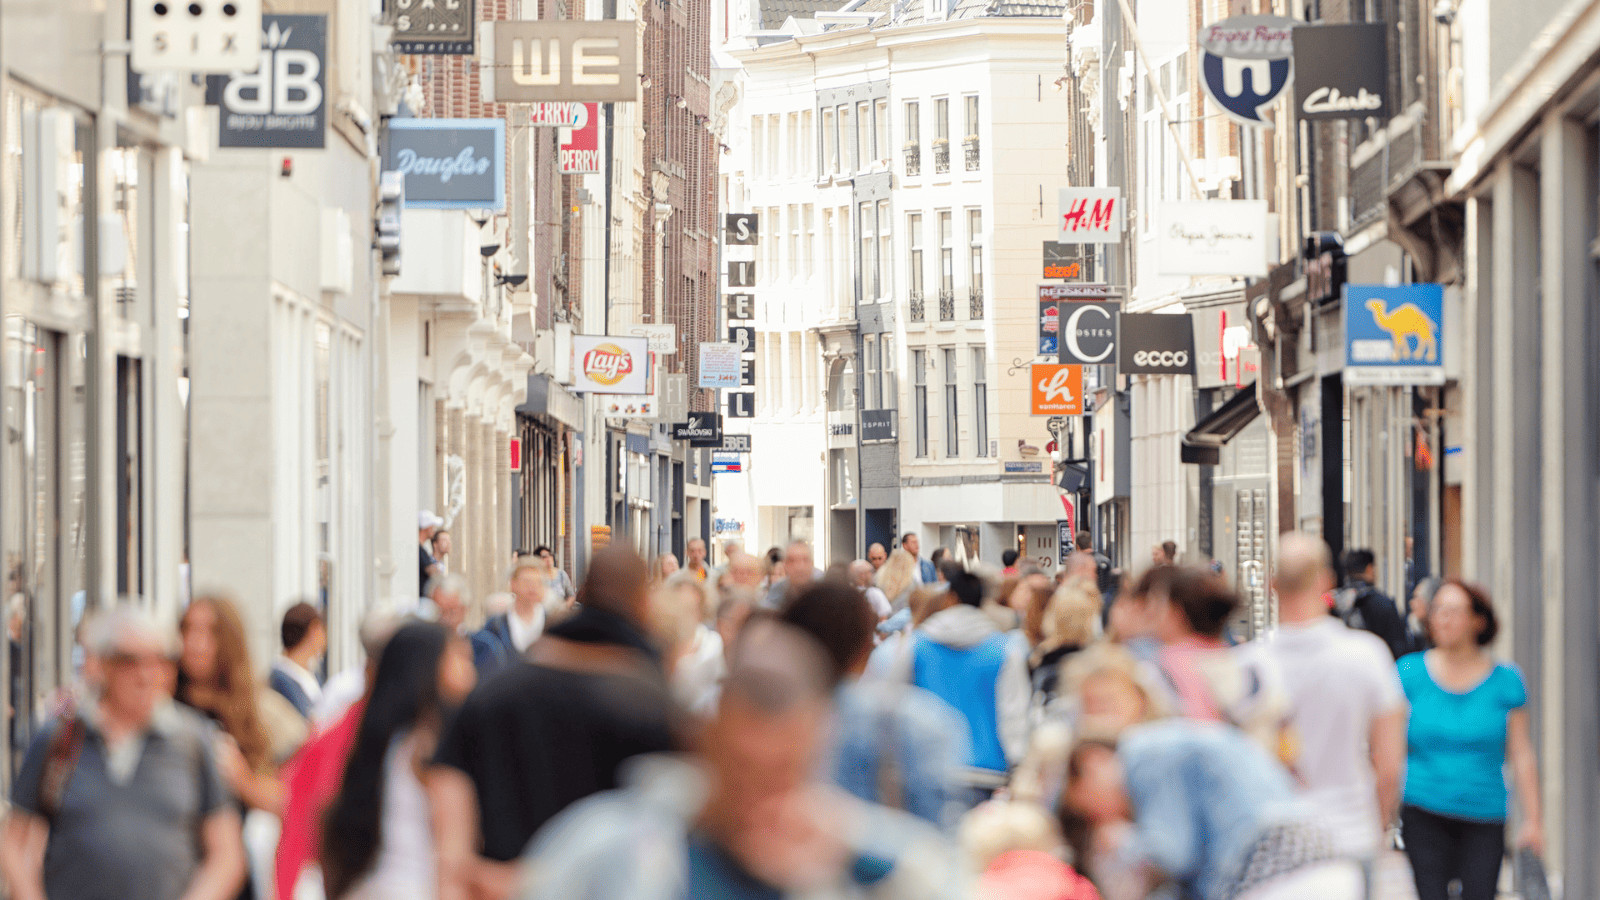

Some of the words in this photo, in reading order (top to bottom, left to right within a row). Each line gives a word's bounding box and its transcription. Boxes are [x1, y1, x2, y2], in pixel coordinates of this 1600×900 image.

[154, 33, 238, 51] SIX
[512, 38, 620, 86] WE
[1303, 86, 1382, 113] Clarks
[529, 103, 571, 126] PERRY
[397, 146, 491, 183] Douglas
[561, 149, 599, 172] PERRY
[1063, 197, 1115, 232] H&M
[1044, 262, 1080, 278] size?
[1040, 288, 1107, 298] REDSKINS
[735, 217, 750, 417] SIEBEL
[585, 351, 633, 379] Lay's
[1133, 350, 1188, 367] ecco
[677, 428, 713, 437] SWAROVSKI
[863, 421, 891, 429] ESPRIT
[713, 437, 750, 451] EBEL
